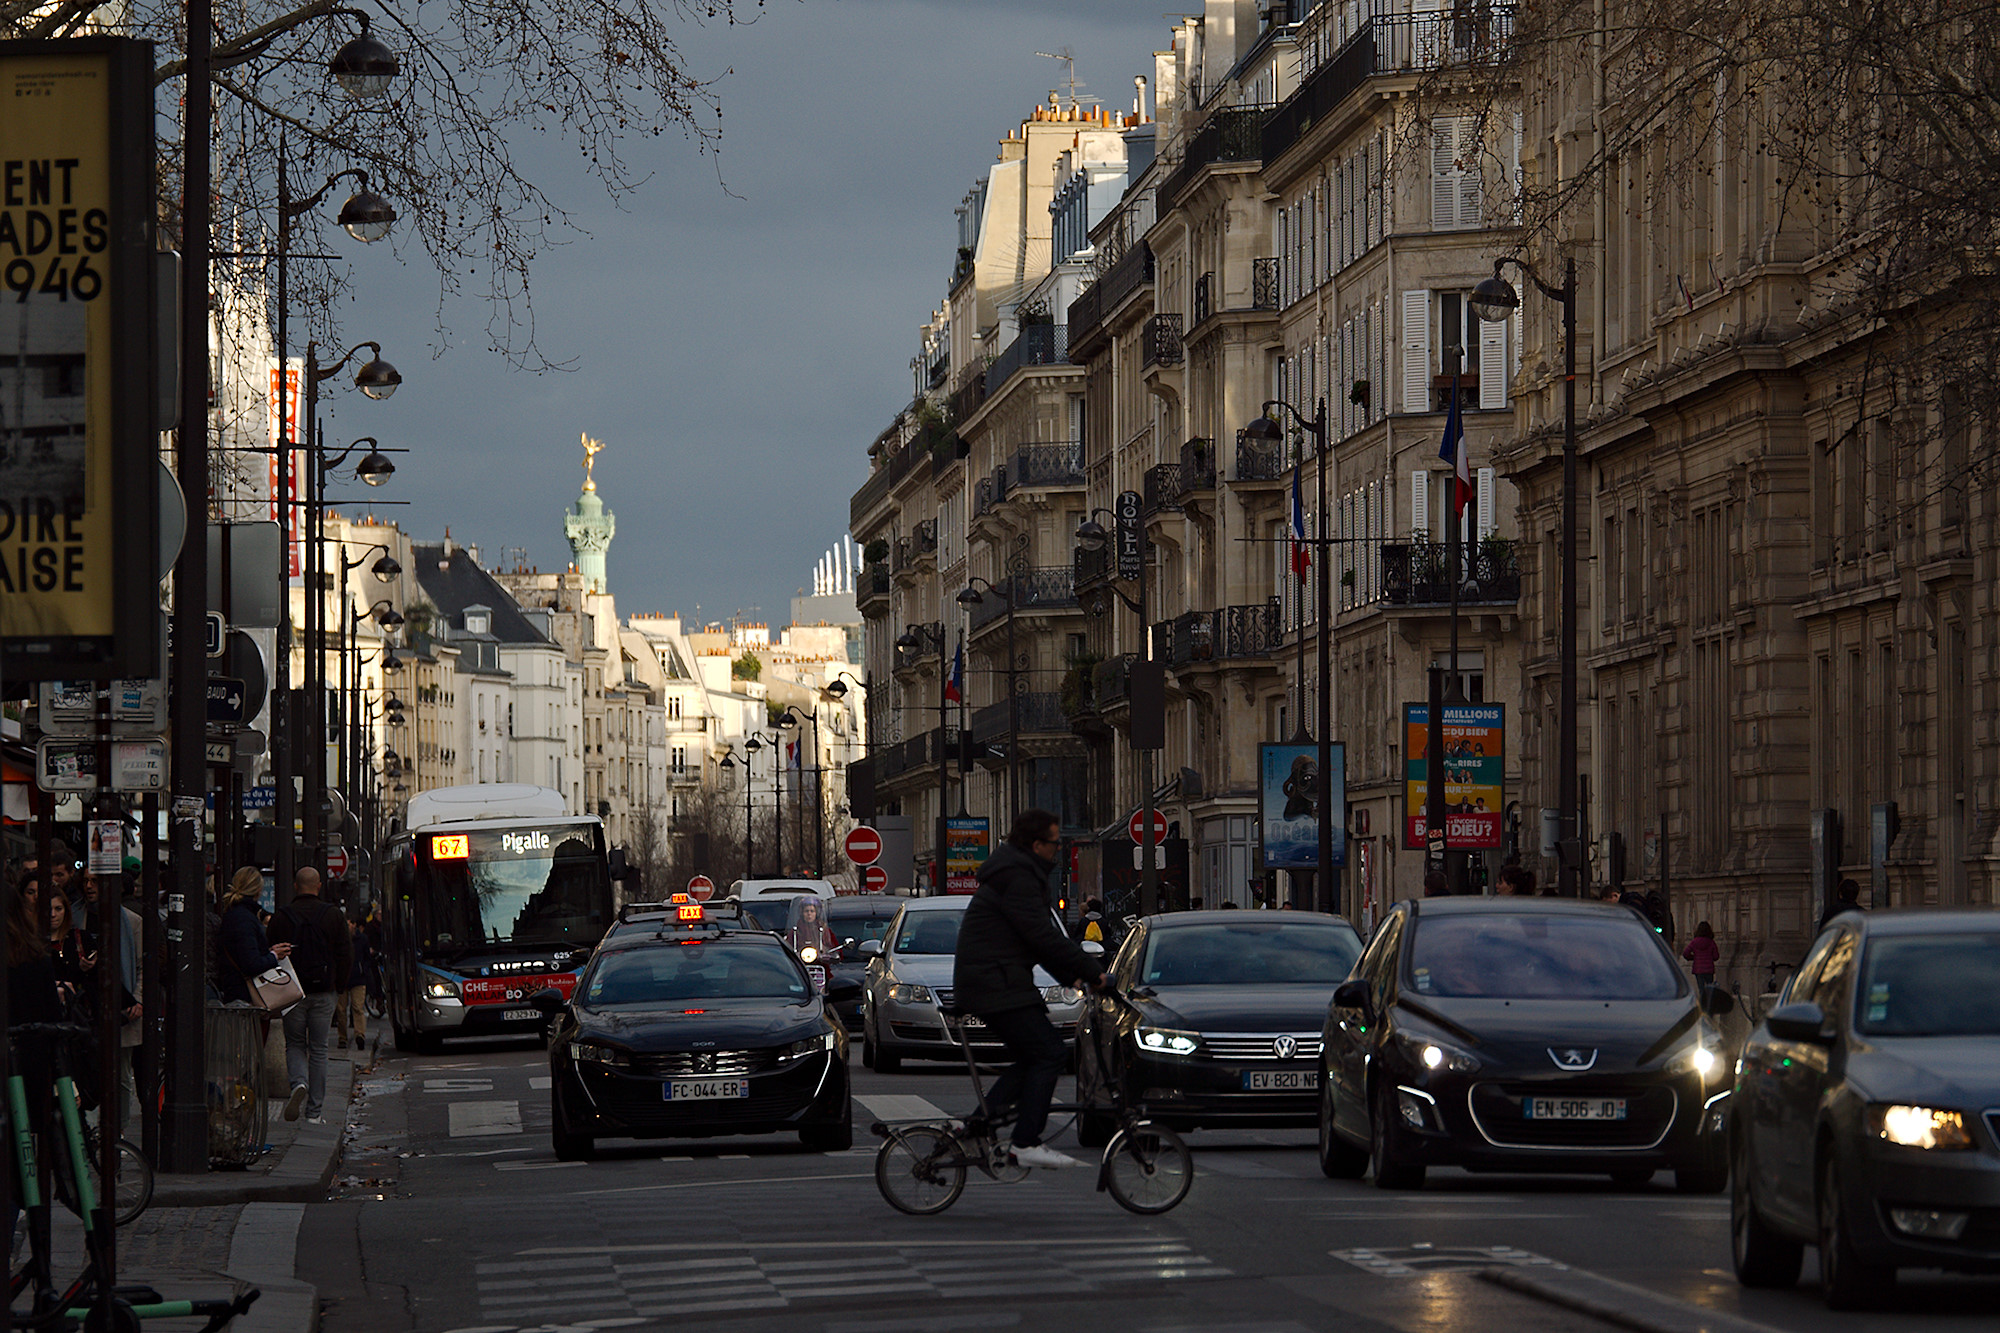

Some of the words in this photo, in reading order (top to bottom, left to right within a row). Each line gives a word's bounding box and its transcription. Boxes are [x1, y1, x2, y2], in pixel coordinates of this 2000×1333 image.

[5, 159, 79, 206] ENT
[0, 256, 102, 303] 946
[1122, 492, 1137, 556] HOTEL
[1444, 709, 1499, 720] MILLIONS
[1450, 728, 1465, 736] DU
[1465, 728, 1488, 736] BIEN
[1457, 759, 1483, 768] RIRES
[439, 839, 461, 856] 67
[502, 831, 550, 856] Pigalle
[672, 894, 688, 903] TAXI
[680, 908, 702, 917] TAXI
[465, 982, 489, 992] CHE
[20, 1129, 35, 1178] TIER
